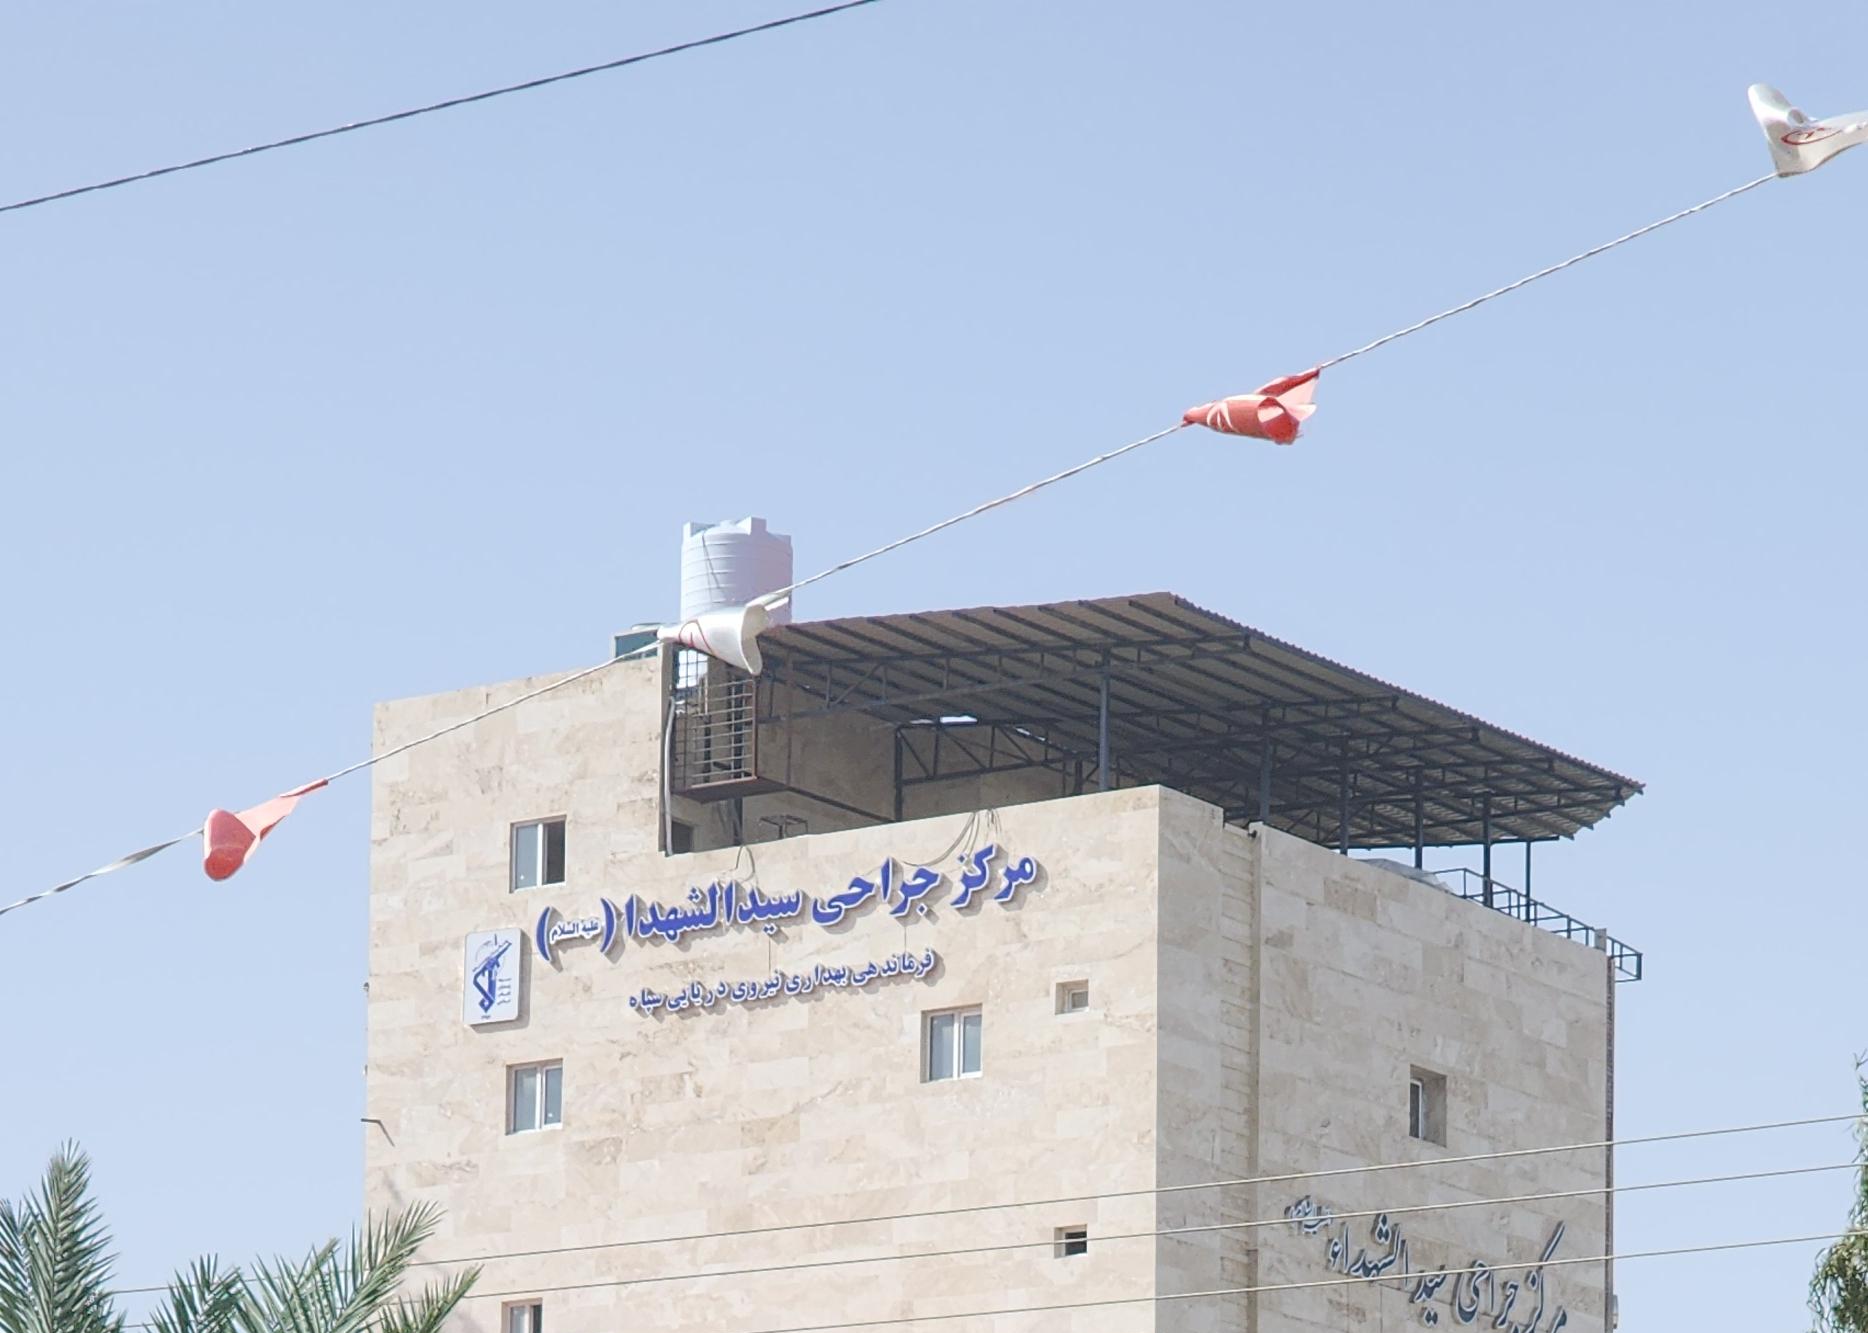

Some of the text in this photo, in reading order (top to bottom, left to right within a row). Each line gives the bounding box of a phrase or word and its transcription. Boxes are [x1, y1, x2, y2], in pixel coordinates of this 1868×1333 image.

[812, 857, 941, 926] جراحی
[950, 843, 1036, 908] مرکز
[629, 948, 935, 1014] فرماندهی بهداری نیروی دریایی سپاه
